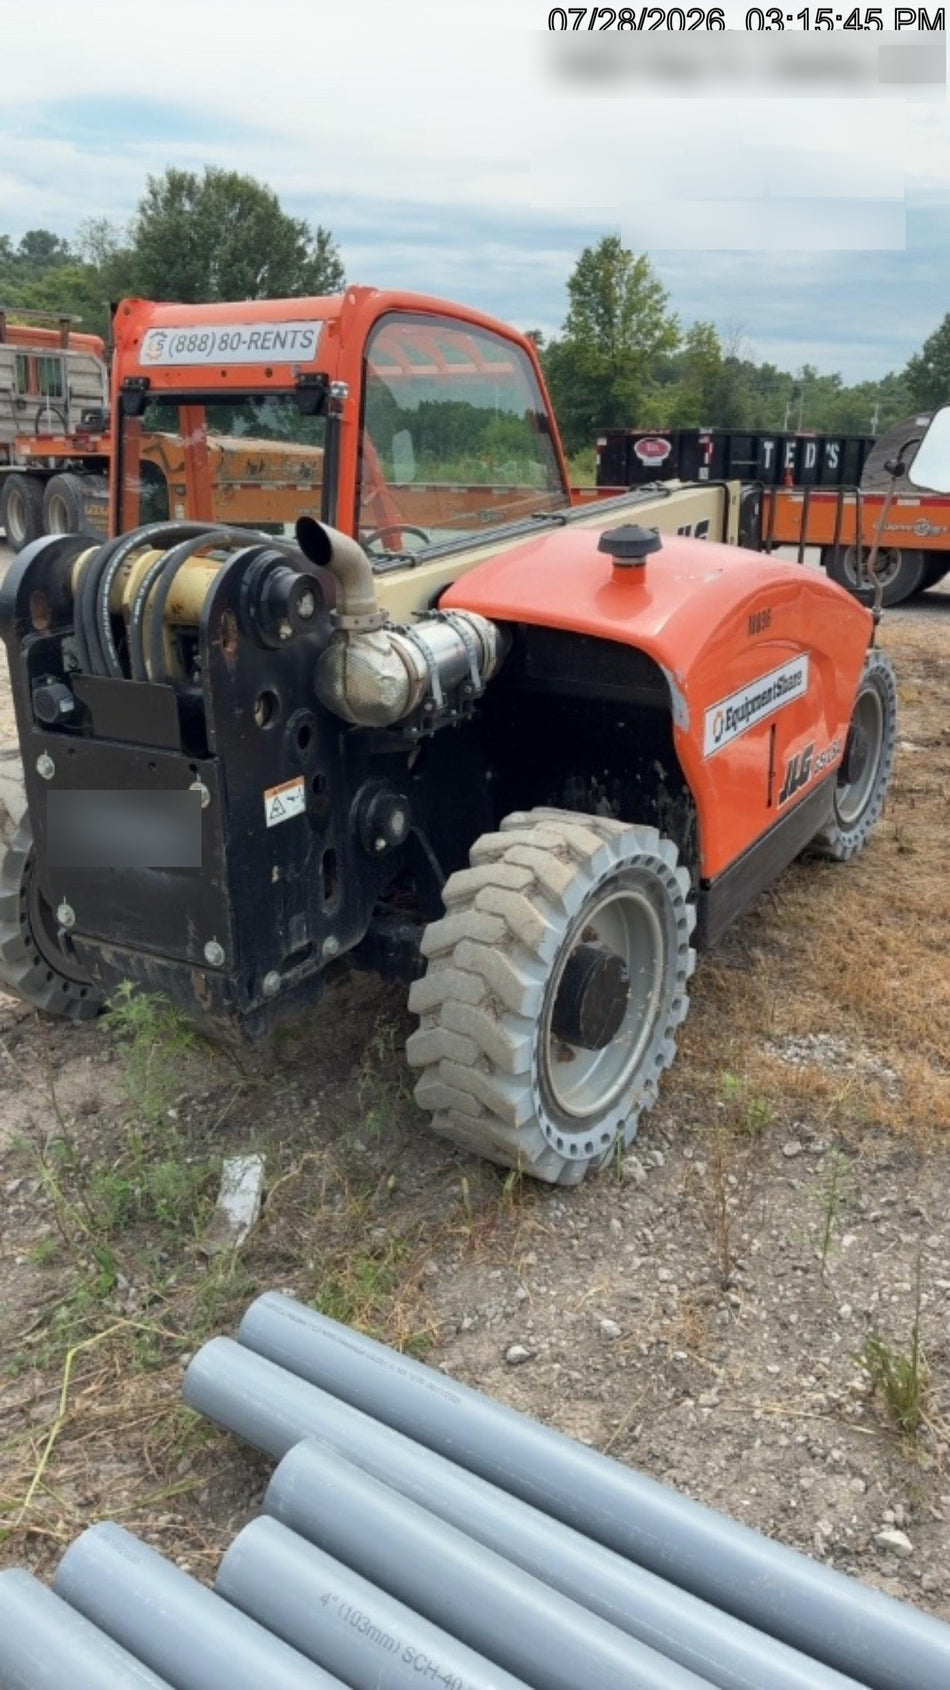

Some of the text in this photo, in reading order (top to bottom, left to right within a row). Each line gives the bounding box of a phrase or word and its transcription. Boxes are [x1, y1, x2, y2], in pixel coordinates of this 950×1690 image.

[725, 669, 803, 732] EquipmentShare
[778, 741, 815, 808] JLG
[337, 1603, 400, 1654] (103mm)
[401, 1645, 464, 1690] SCH-40
